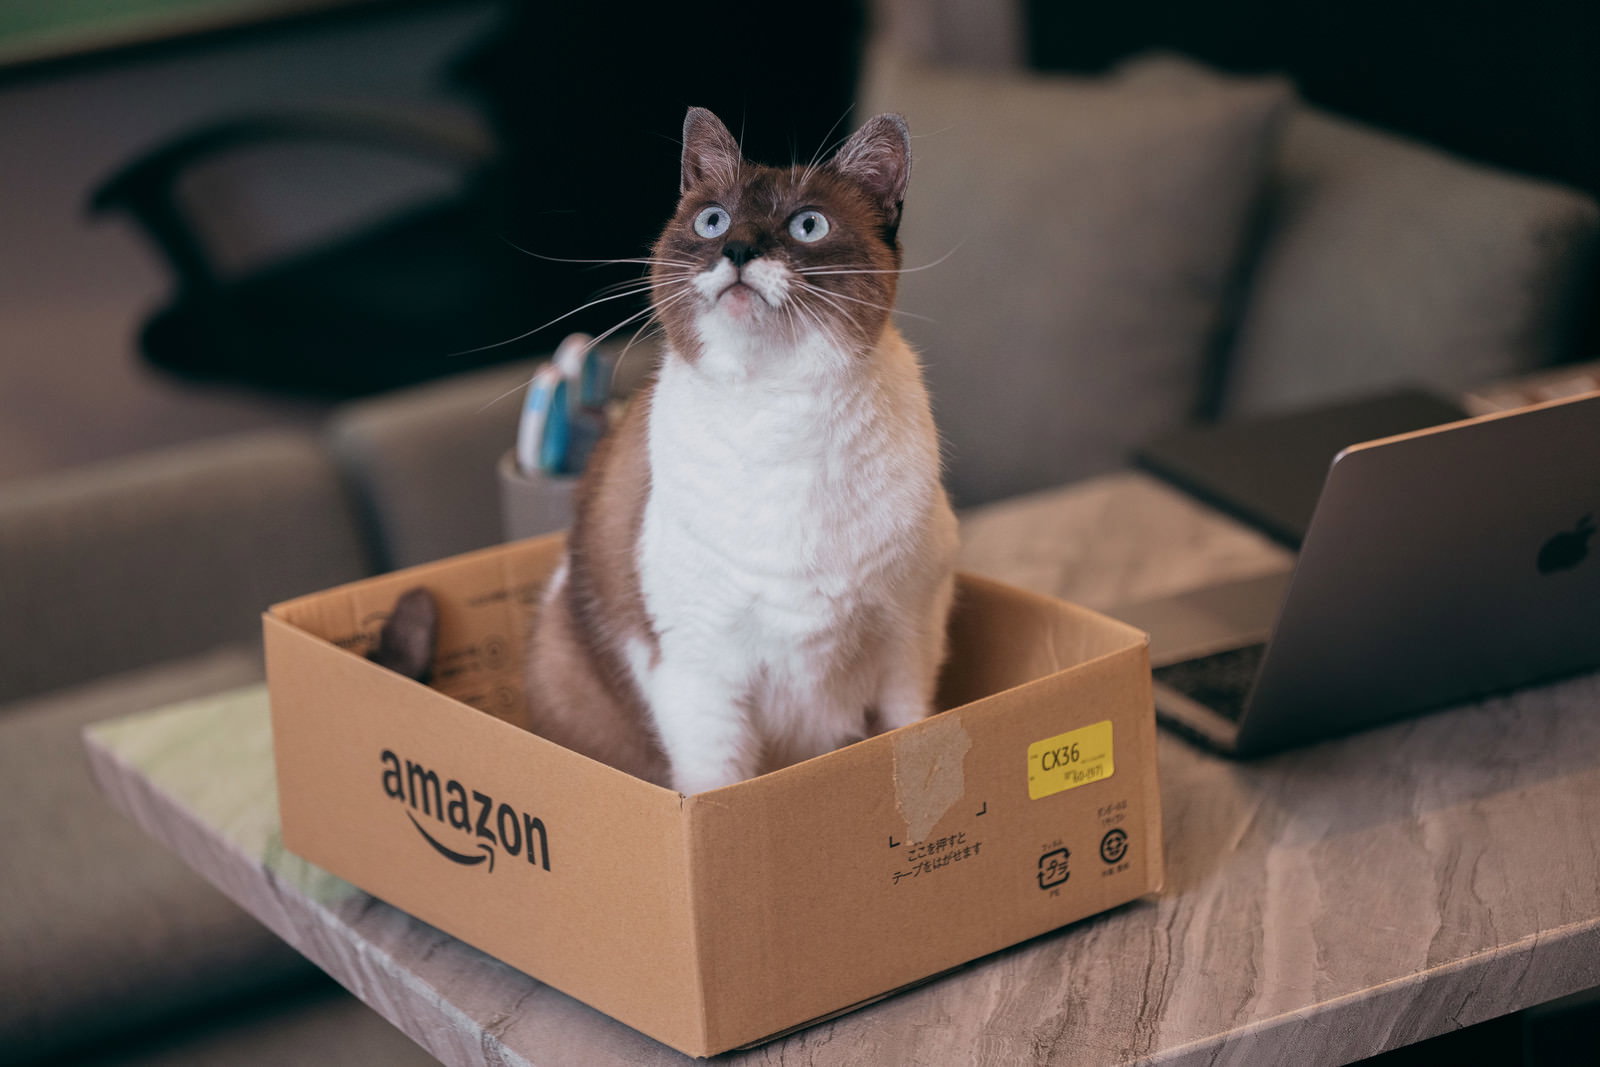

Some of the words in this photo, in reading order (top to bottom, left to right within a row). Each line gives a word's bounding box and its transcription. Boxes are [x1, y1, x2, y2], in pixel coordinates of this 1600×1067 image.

[1042, 743, 1080, 772] CX36
[381, 749, 551, 873] amazon
[908, 832, 967, 862] ここを押すと
[892, 842, 982, 885] テープをはがせます
[1046, 859, 1069, 881] プラ
